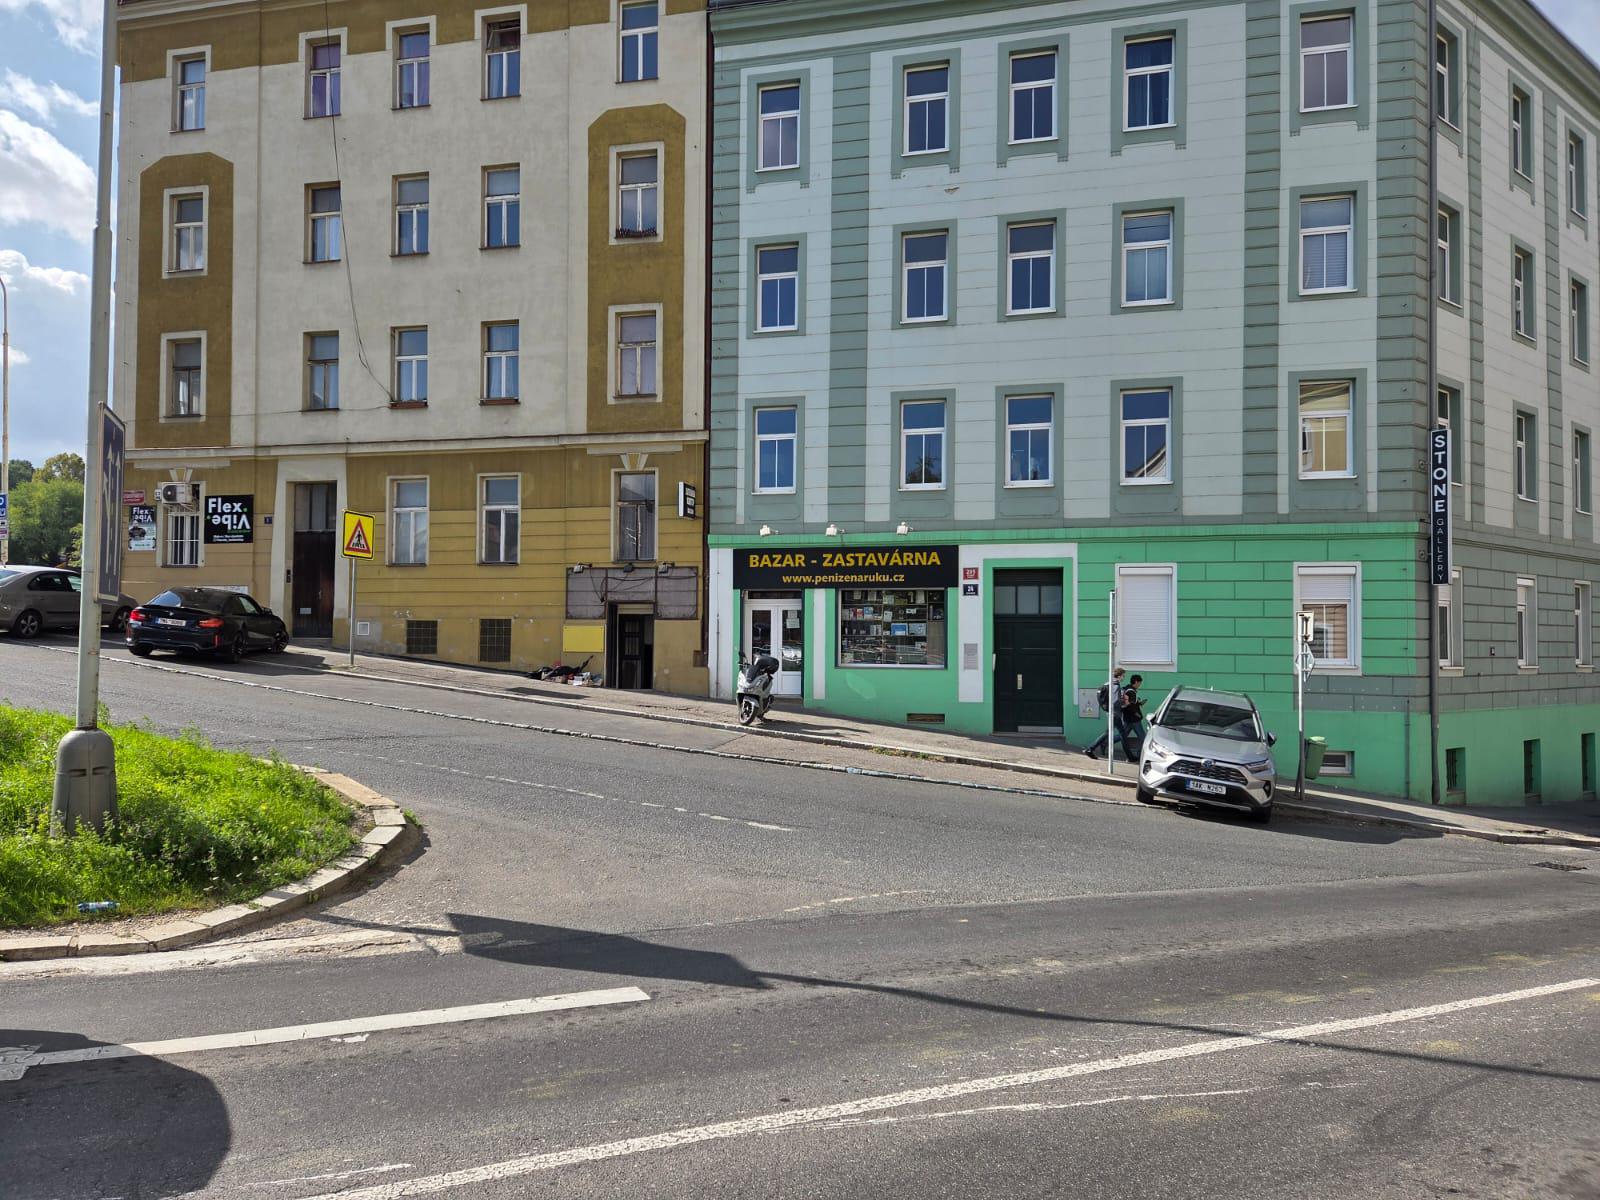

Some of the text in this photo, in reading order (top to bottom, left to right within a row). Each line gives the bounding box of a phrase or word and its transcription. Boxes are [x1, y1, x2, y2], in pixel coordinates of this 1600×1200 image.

[1433, 435, 1447, 513] STONE
[749, 554, 806, 568] BAZAR
[822, 549, 942, 567] ZASTAVÁRNA
[1436, 518, 1445, 581] GALLERY
[782, 572, 906, 585] www.penizenaruku.cz
